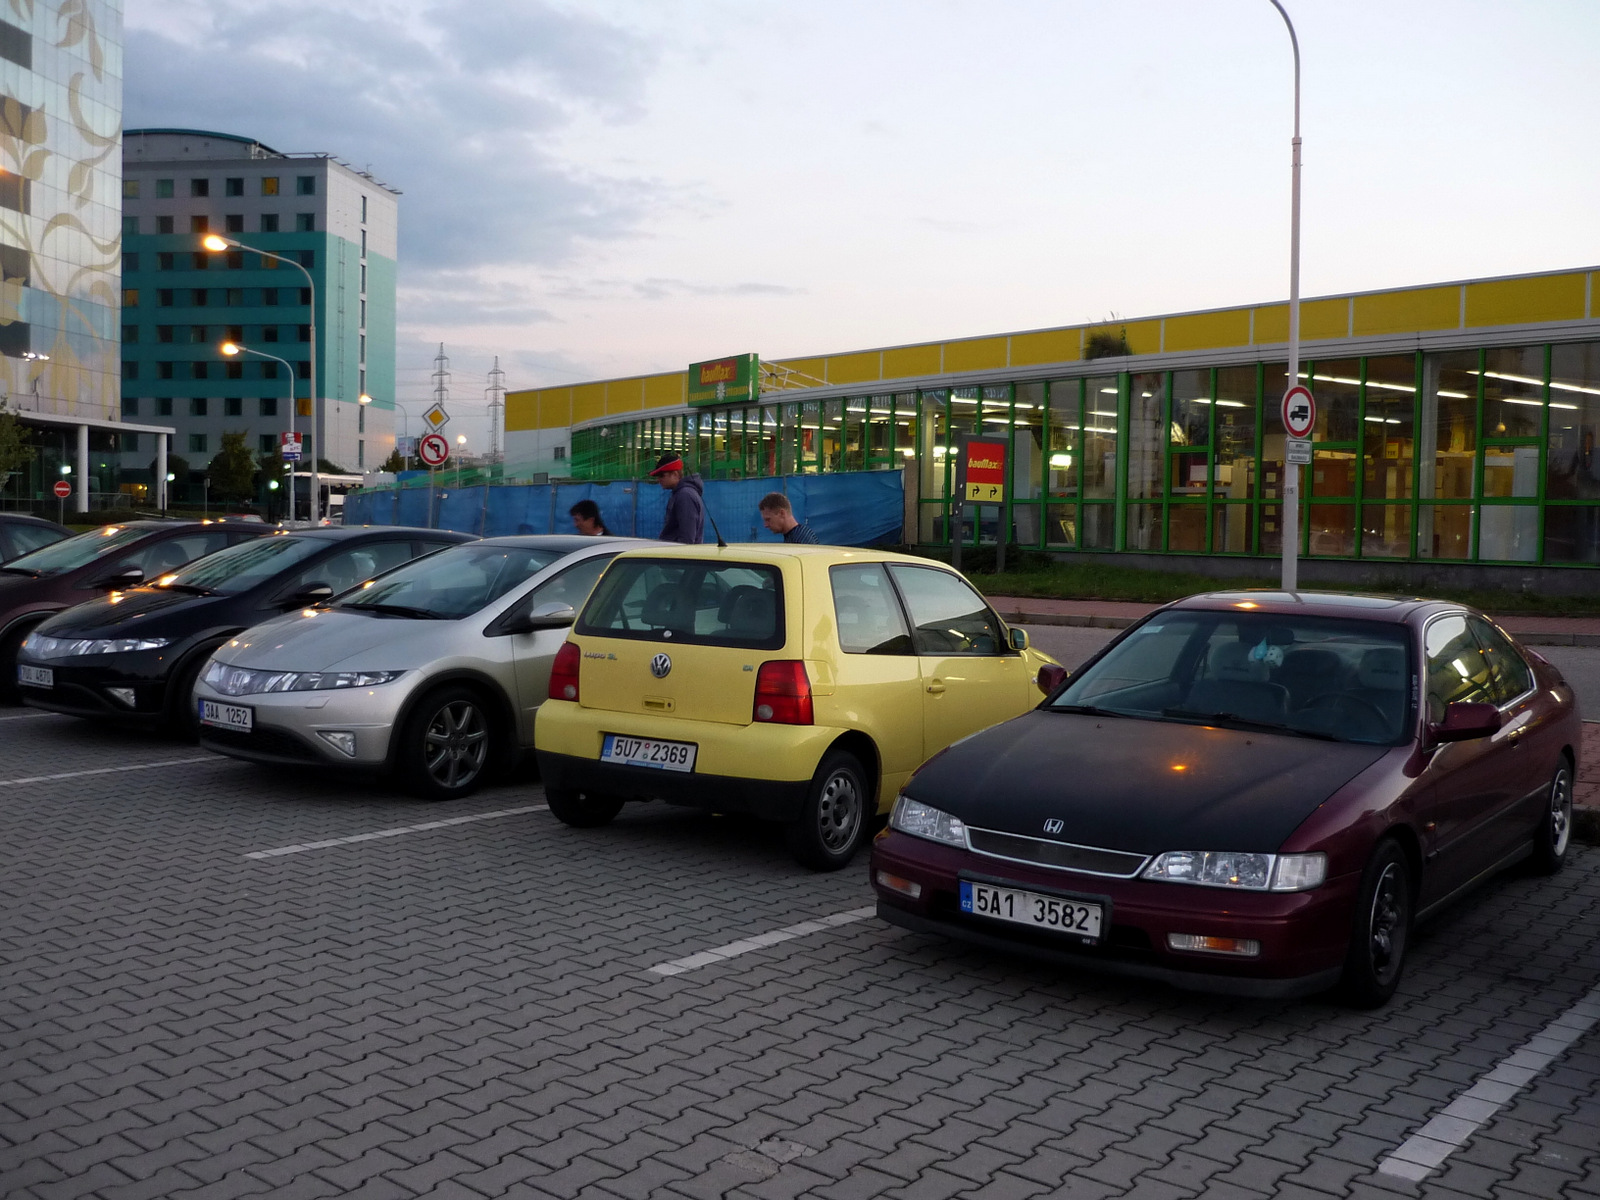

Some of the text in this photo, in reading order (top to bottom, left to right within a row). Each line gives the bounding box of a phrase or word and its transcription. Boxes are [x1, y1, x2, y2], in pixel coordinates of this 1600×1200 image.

[205, 703, 248, 725] 3AA 1252
[615, 739, 688, 764] 5U7 2369
[977, 888, 1090, 932] 5A1 3582
